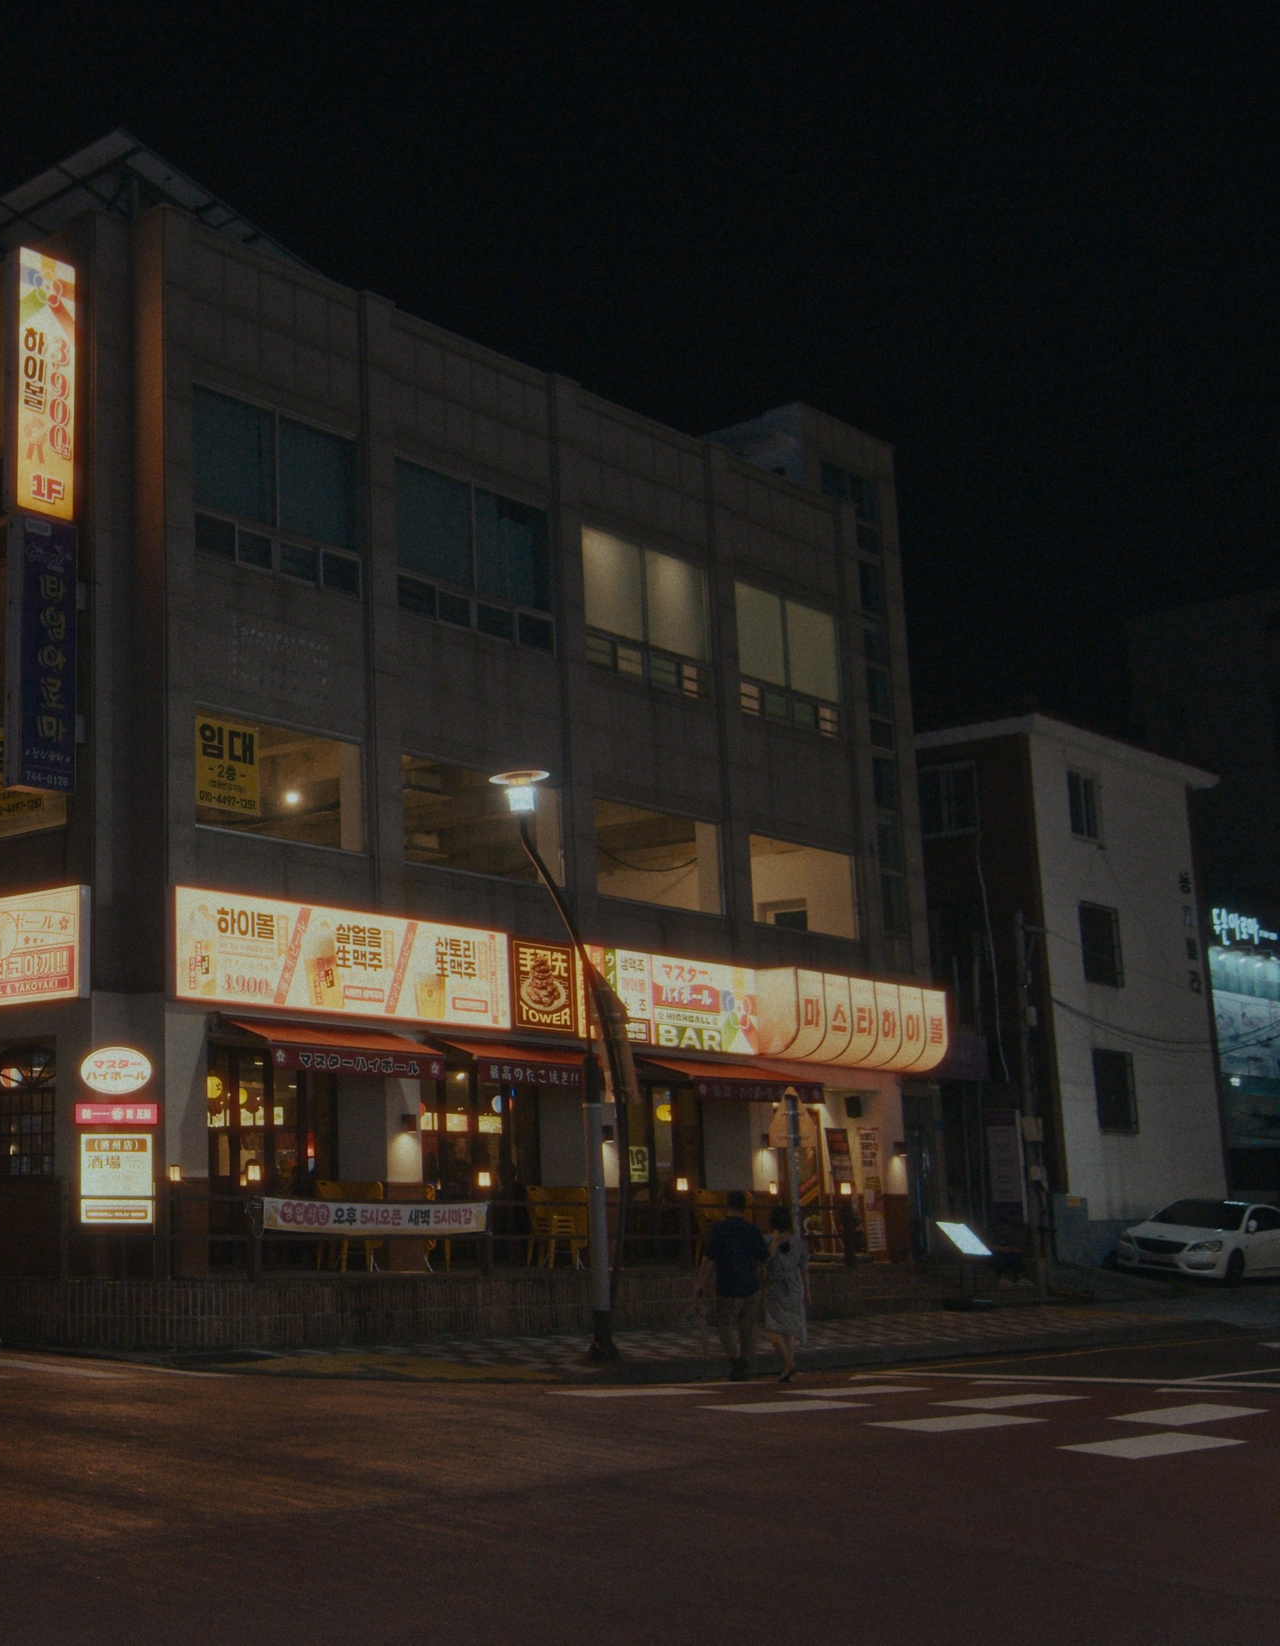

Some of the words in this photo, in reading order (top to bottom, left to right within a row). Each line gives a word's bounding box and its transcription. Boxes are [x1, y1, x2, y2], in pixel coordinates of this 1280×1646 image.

[23, 327, 46, 411] 하이볼
[31, 474, 64, 502] 1F
[199, 723, 255, 765] 임대
[25, 771, 70, 788] 744-0126
[199, 790, 256, 811] 010-4497-1251
[216, 906, 275, 940] 하이볼
[335, 922, 382, 949] 살얼음
[335, 945, 383, 972] 生맥주
[434, 936, 476, 961] 산토리
[434, 955, 477, 980] 生맥주
[620, 956, 645, 973] 생맥주
[661, 964, 709, 983] マスター
[15, 979, 59, 993] TAKOYAKI
[621, 976, 647, 993] 하이볼
[661, 986, 713, 1007] ハイボール
[519, 1000, 571, 1026] TOWER
[803, 997, 943, 1045] 마스타하이볼
[658, 1025, 722, 1052] BAR
[86, 1071, 147, 1081] ハイボール
[93, 1060, 141, 1070] マスター
[298, 1052, 419, 1076] マスターハイボール
[282, 1203, 330, 1223] 영업시간
[332, 1207, 358, 1226] 오후
[360, 1207, 403, 1227] 5시오픈
[407, 1208, 430, 1226] 새벽
[433, 1207, 473, 1226] 5시마감
